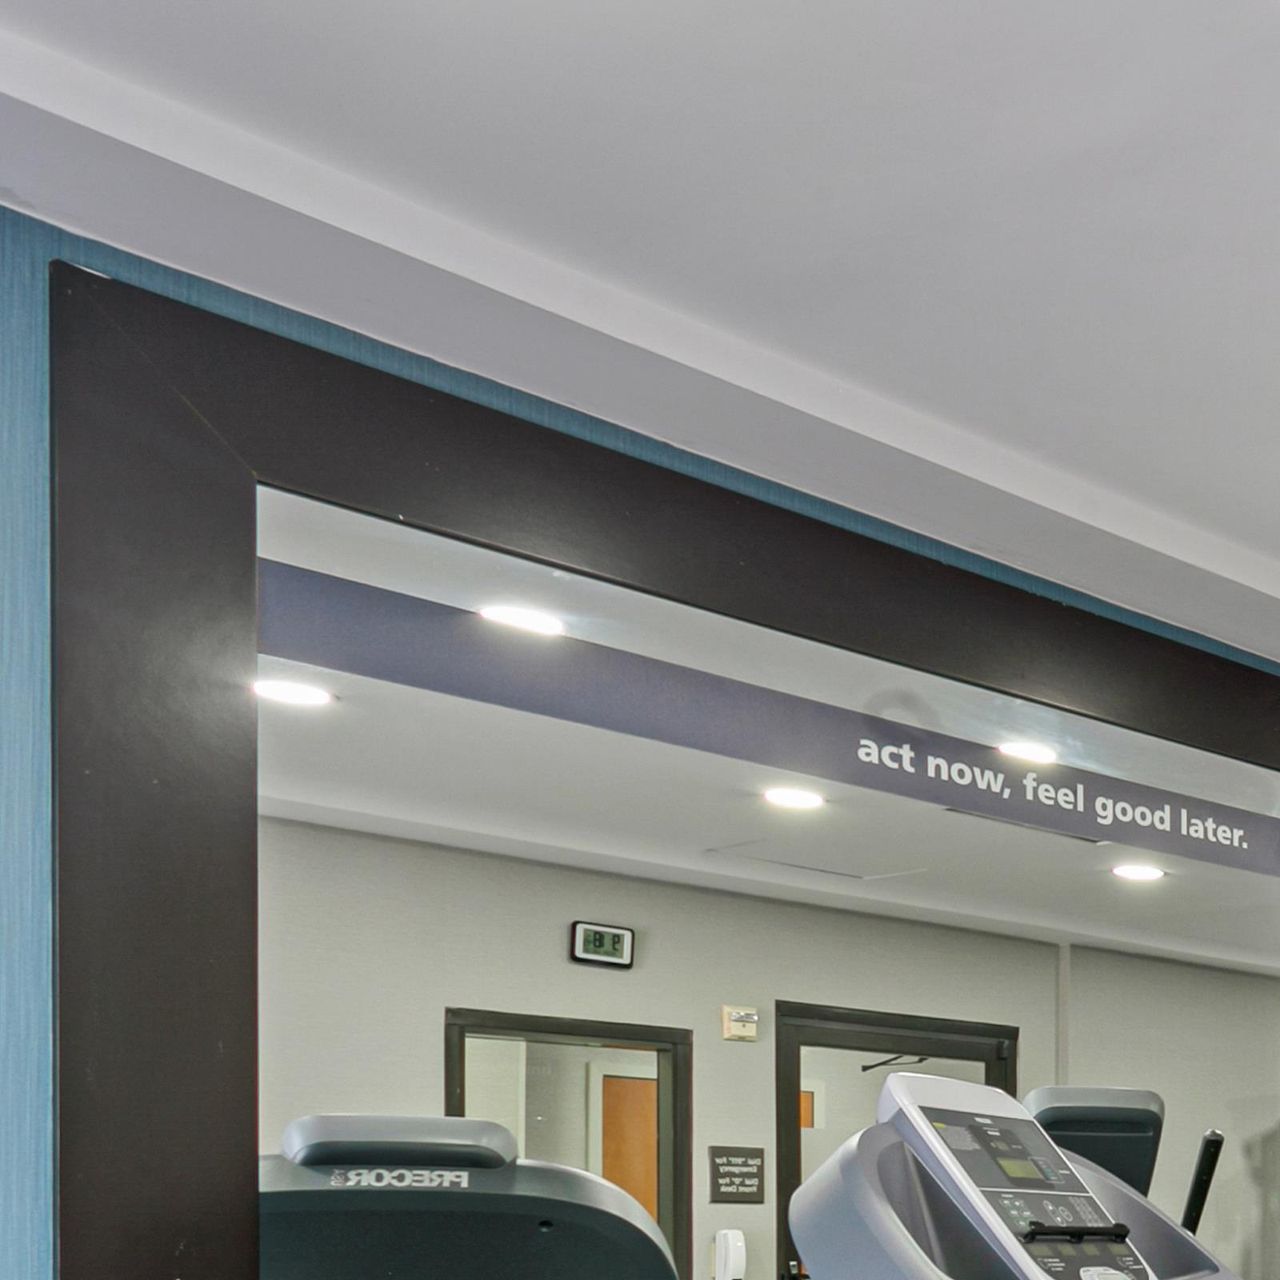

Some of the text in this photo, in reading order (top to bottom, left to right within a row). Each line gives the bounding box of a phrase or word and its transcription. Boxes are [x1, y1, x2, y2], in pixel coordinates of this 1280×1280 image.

[857, 738, 1249, 849] act now, feel good later.
